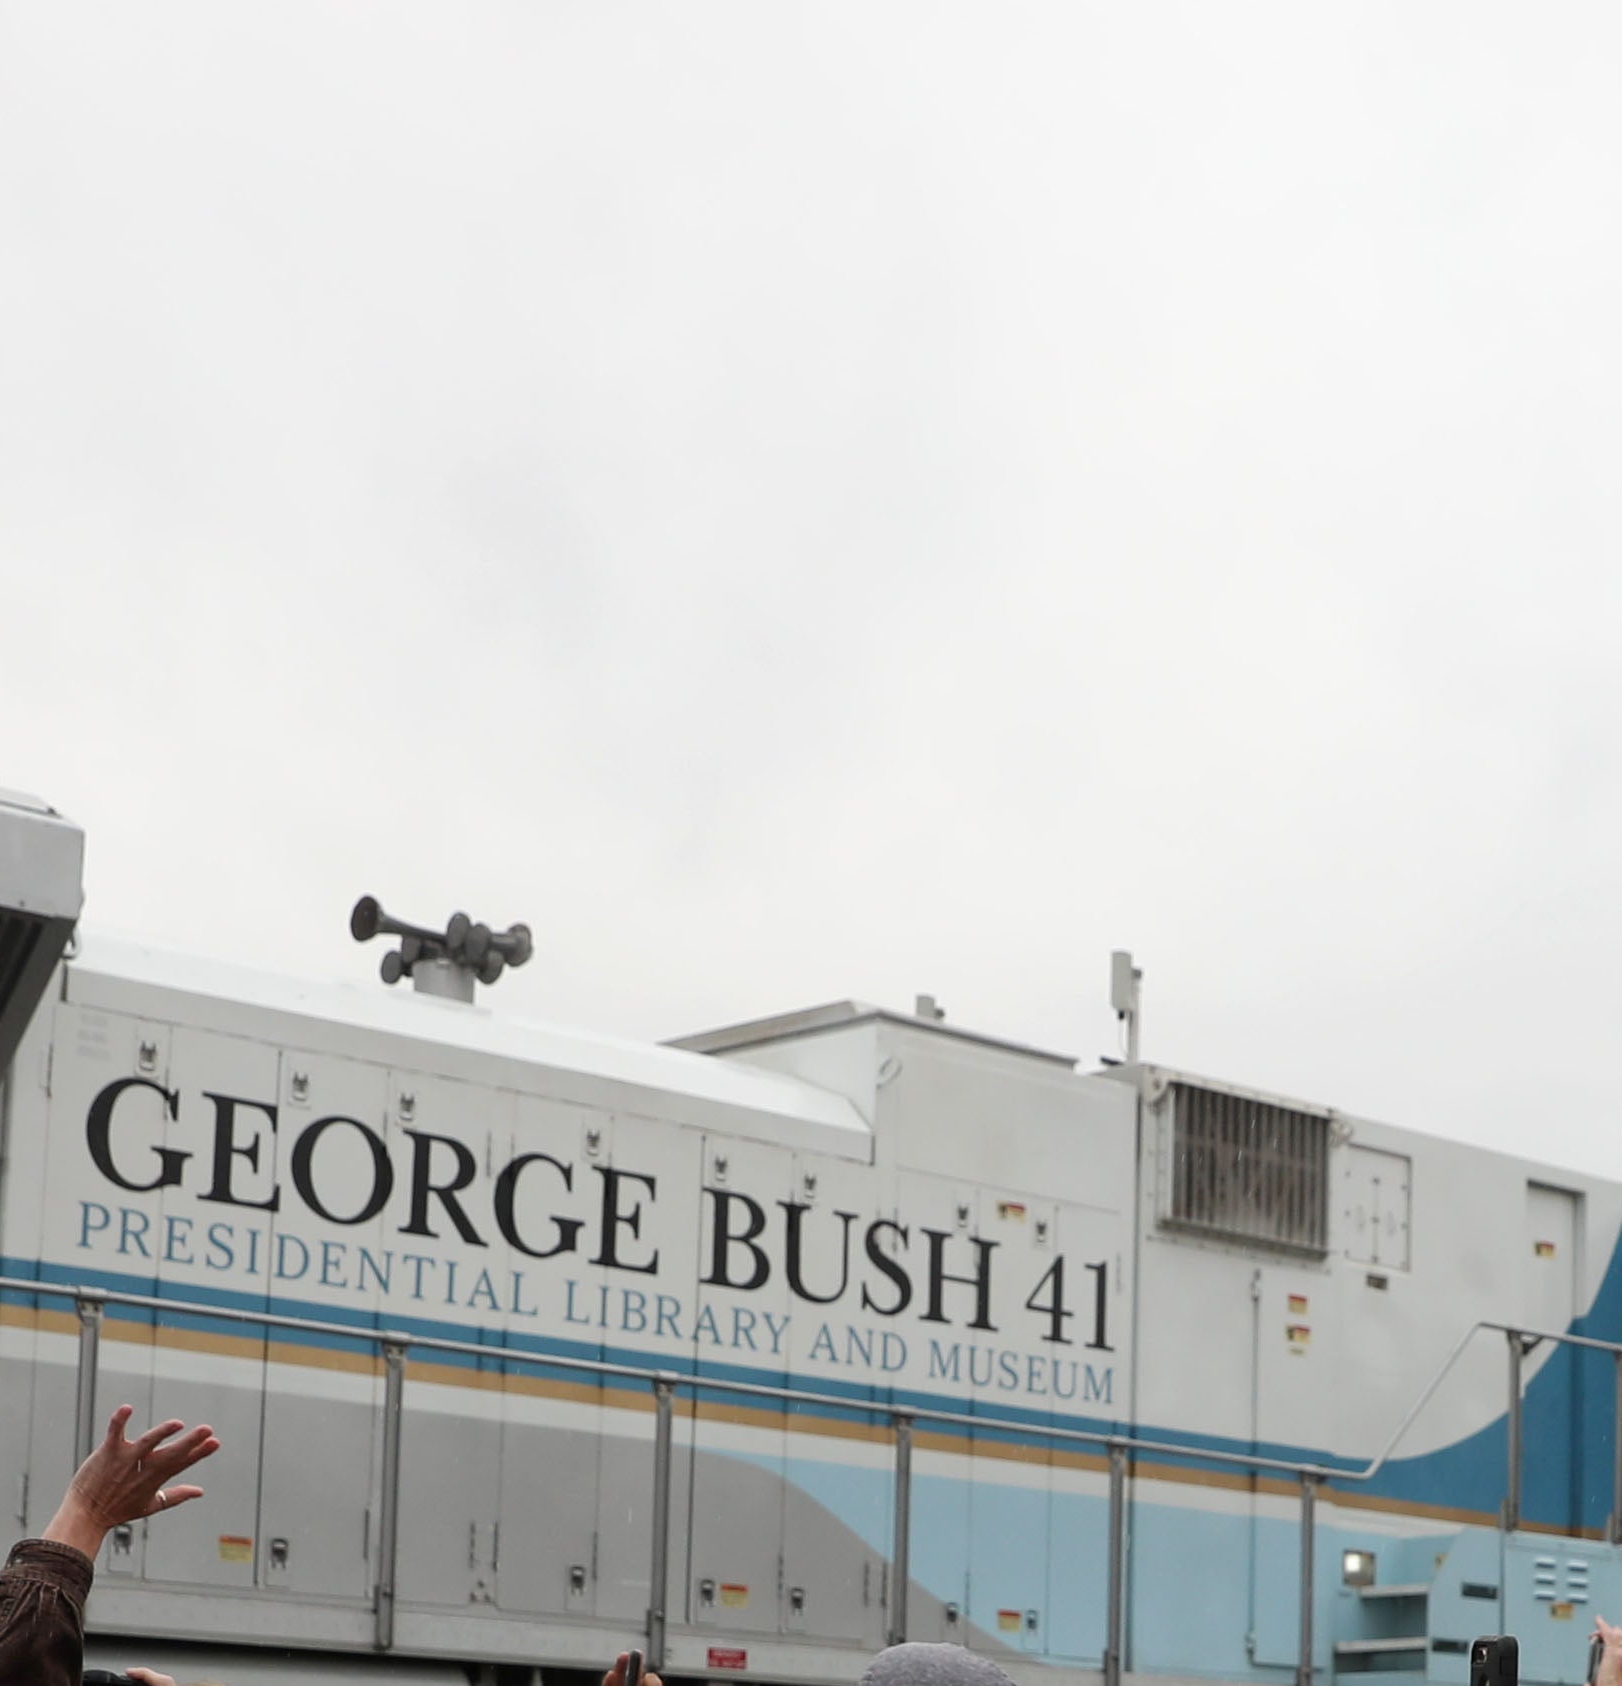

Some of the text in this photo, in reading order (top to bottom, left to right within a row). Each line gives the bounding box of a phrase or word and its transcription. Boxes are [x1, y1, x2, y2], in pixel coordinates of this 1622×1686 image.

[76, 1200, 1116, 1405] PRESIDENTIAL LIBRARY AND MUSEUM
[85, 1076, 1116, 1353] GEORGE BUSH 41
